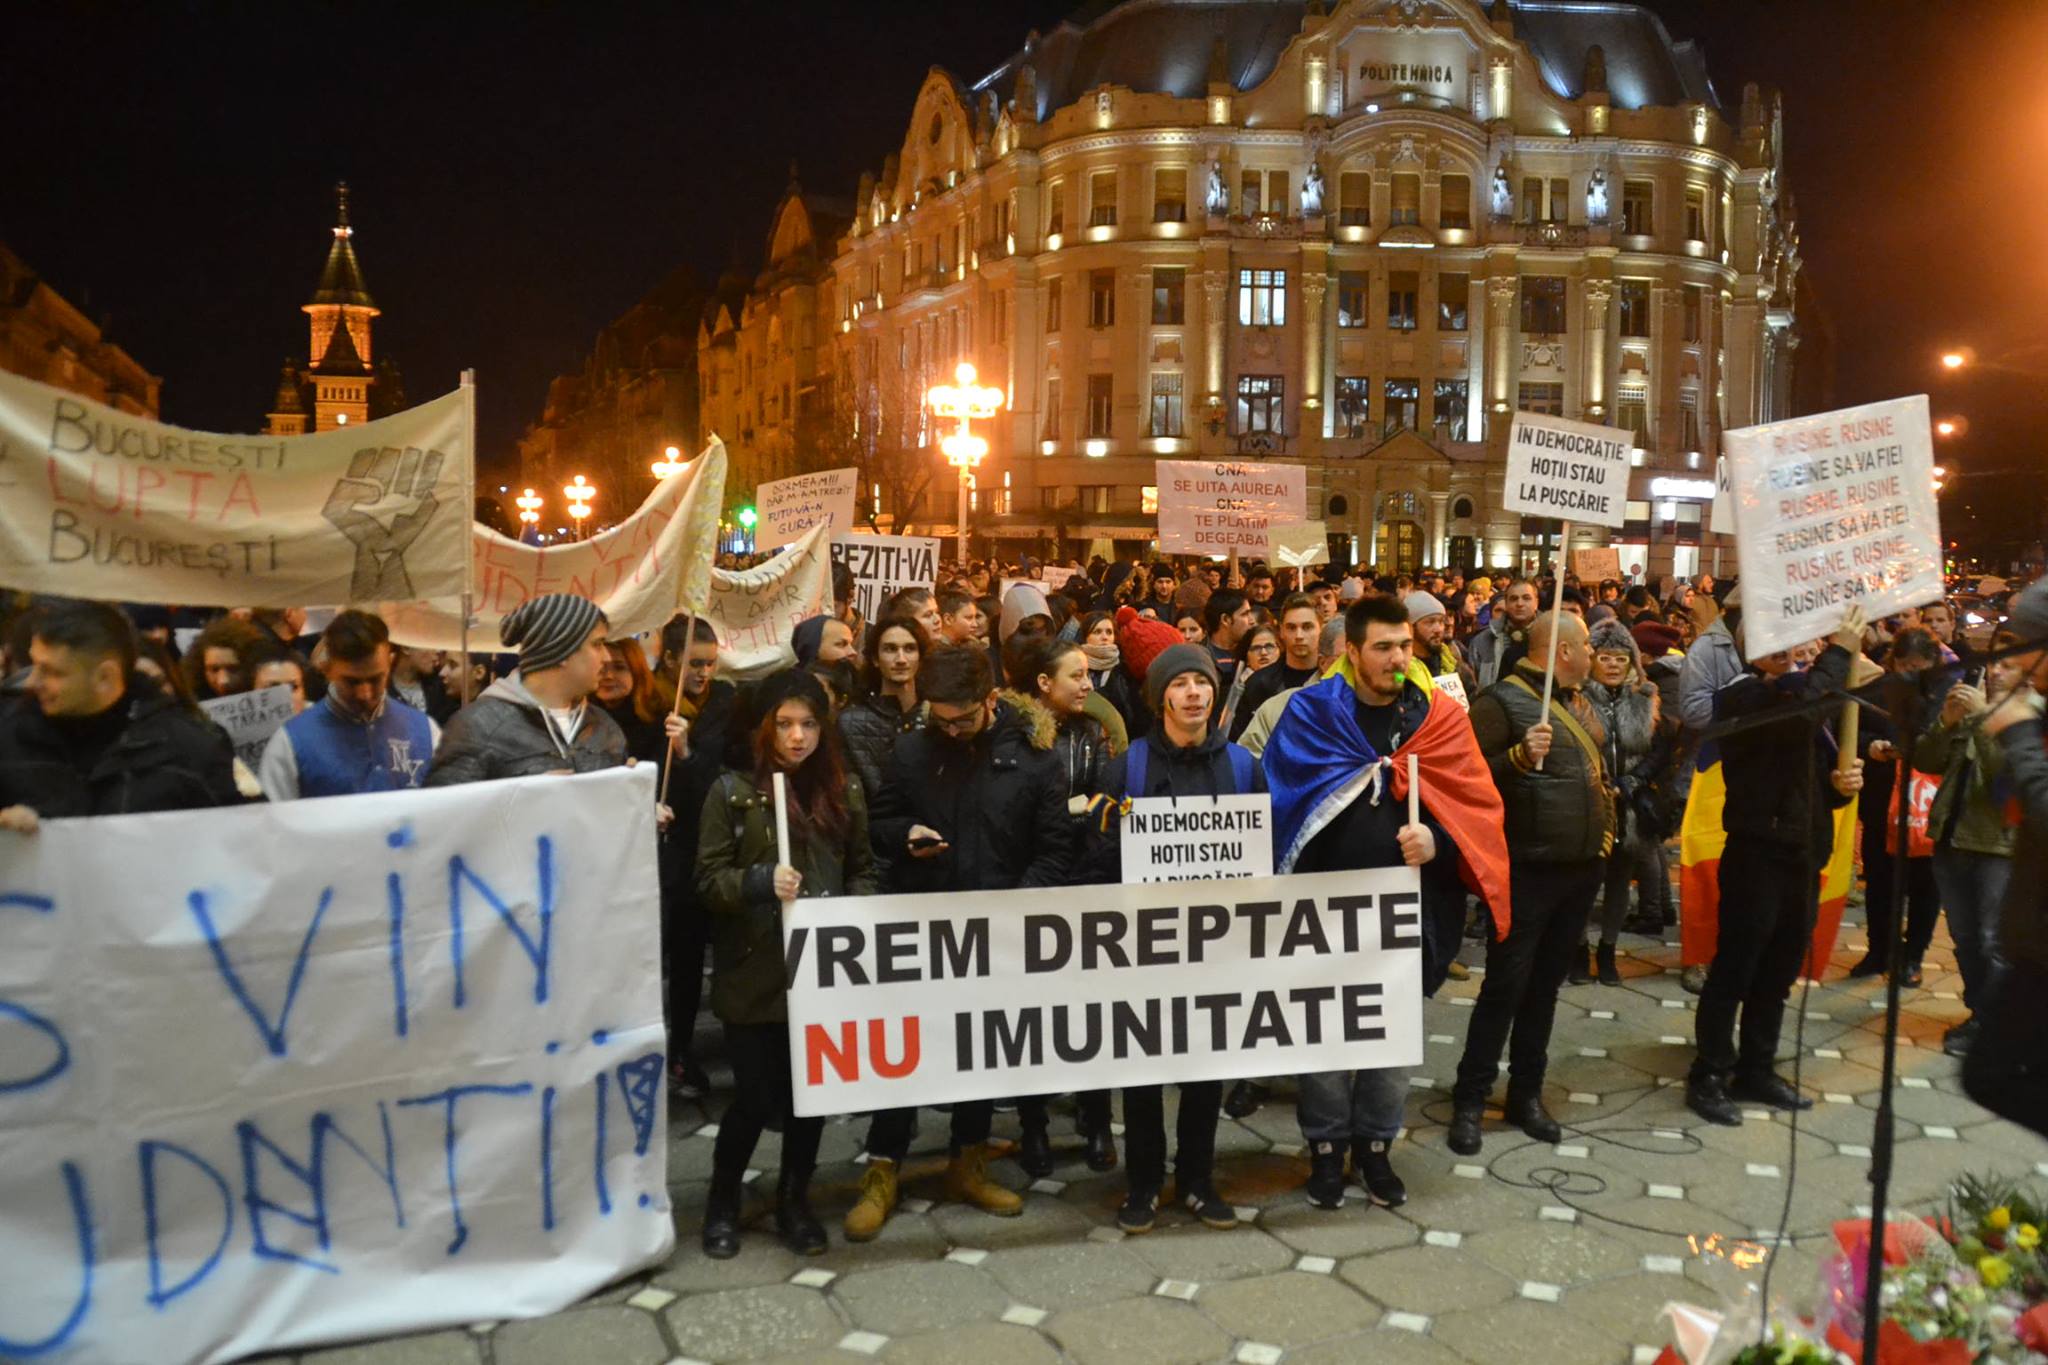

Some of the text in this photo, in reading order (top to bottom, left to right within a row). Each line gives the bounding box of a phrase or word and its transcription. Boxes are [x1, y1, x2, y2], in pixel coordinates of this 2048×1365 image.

[1360, 63, 1453, 84] POLITEHNICA
[1840, 416, 1896, 444] RUSINE
[1215, 463, 1247, 477] CNA
[1570, 463, 1606, 485] STAU
[1833, 456, 1854, 478] SA
[1854, 450, 1875, 474] VA
[1875, 444, 1904, 468] FIE!
[46, 456, 262, 524] LUPTA
[1173, 480, 1288, 497] SE UITA AIUREA!
[1519, 483, 1537, 502] LA
[1846, 476, 1901, 505] RUSINE
[1216, 498, 1248, 511] CNA
[1194, 514, 1268, 529] TE PLATIM
[1775, 504, 1911, 554] RUSINE SA VA FIE!
[1195, 531, 1269, 547] DEGEABA!
[1852, 535, 1907, 567] RUSINE
[1782, 583, 1841, 619] RUSINE
[1843, 576, 1866, 600] SA
[1152, 809, 1263, 834] DEMOCRAȚIE
[1199, 842, 1242, 863] STAU
[188, 824, 552, 1058] VIN
[1024, 892, 1422, 974] DREPTATE
[805, 983, 1386, 1087] NU IMUNITATE
